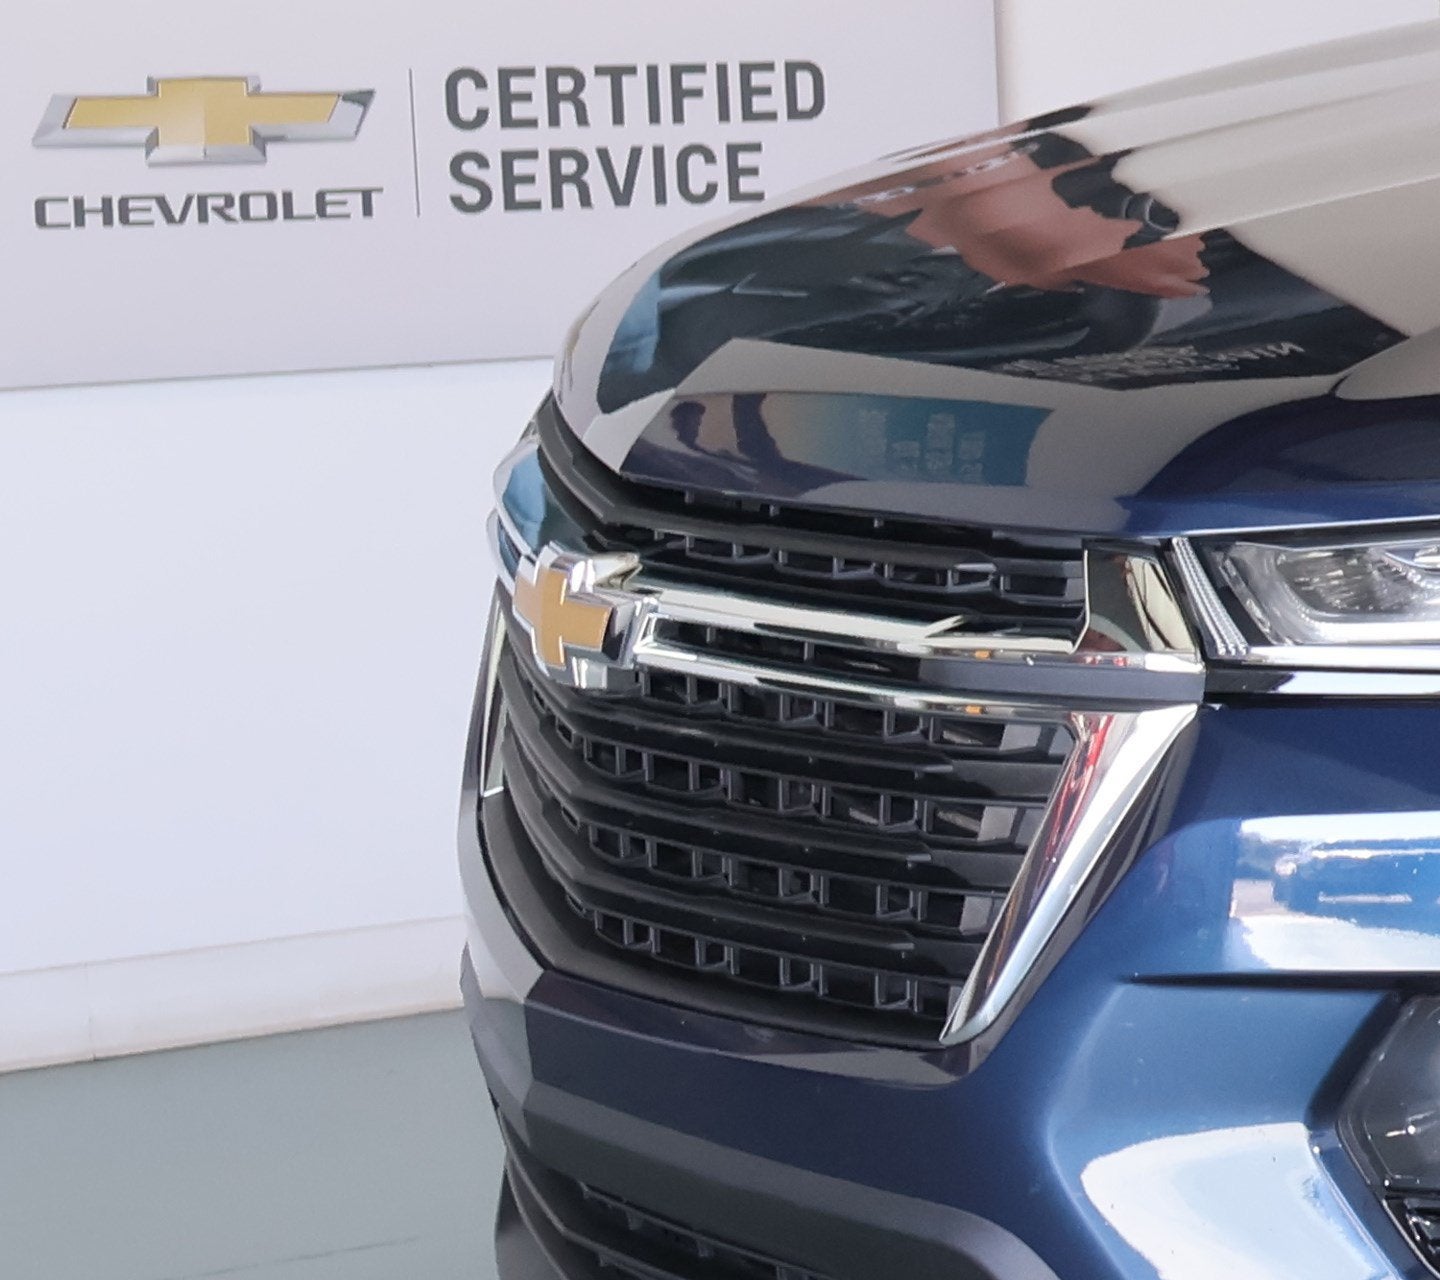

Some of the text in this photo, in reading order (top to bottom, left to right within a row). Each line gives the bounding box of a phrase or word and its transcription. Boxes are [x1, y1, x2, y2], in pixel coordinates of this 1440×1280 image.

[443, 60, 826, 131] CERTIFIED
[33, 186, 385, 229] CHEVROLET
[447, 141, 767, 214] SERVICE
